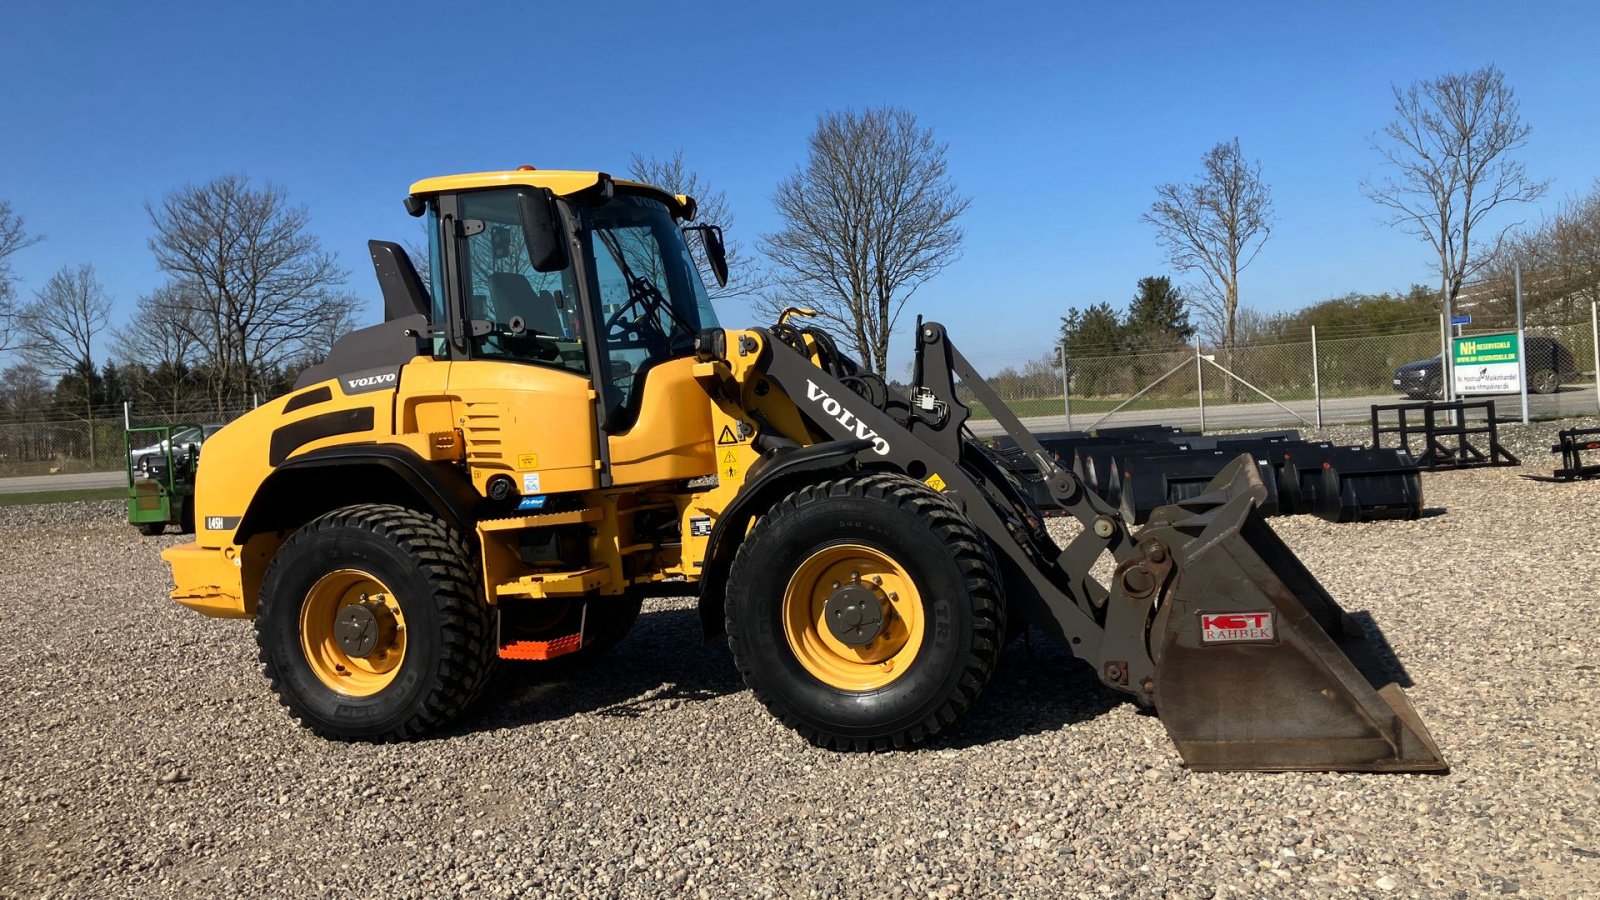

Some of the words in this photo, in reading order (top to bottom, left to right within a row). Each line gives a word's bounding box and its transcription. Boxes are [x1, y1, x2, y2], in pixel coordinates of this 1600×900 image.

[1460, 341, 1476, 355] NH
[348, 373, 396, 388] VOLVO
[806, 379, 890, 456] VOLVO
[208, 517, 224, 530] L45H
[1206, 628, 1272, 640] RAHBEK
